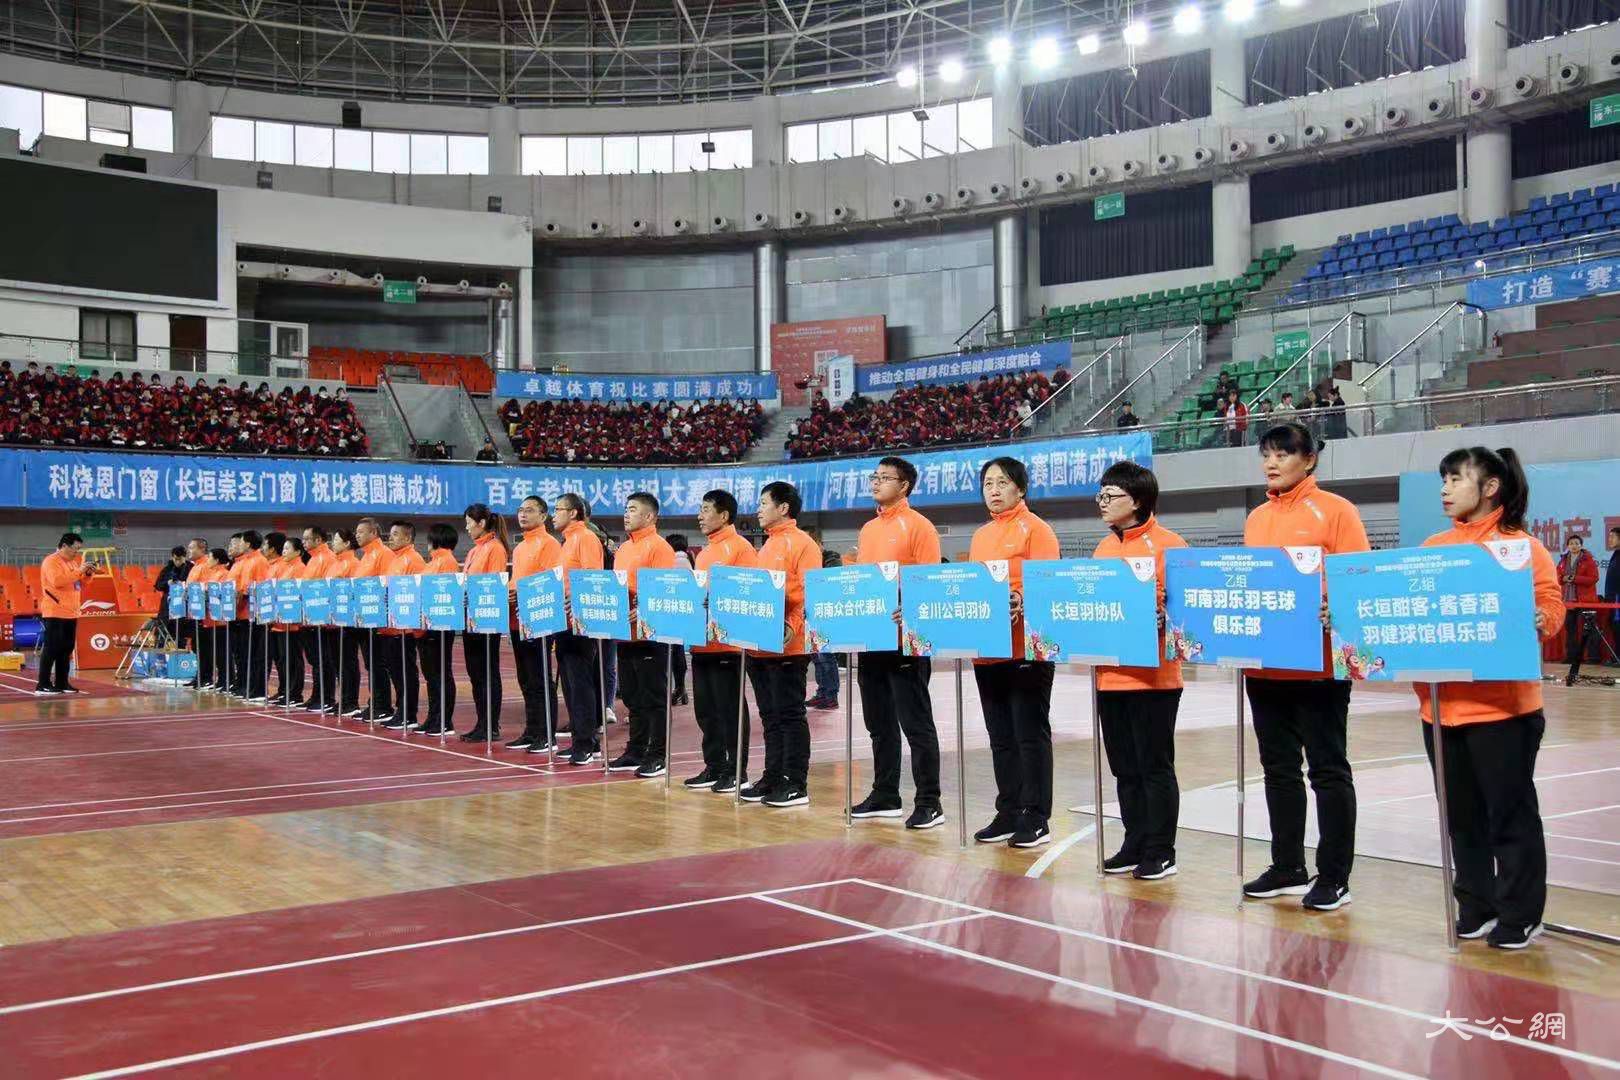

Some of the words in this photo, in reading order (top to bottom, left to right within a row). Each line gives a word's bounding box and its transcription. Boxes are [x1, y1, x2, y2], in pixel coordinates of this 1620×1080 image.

[869, 351, 1041, 385] 推动全民健身和全民健康深度融合
[1077, 582, 1096, 595] 乙组
[1224, 574, 1248, 588] 乙组
[1407, 577, 1436, 593] 乙组
[647, 597, 695, 614] 新乡羽林军队
[716, 596, 775, 618] 七零羽客代表队
[814, 598, 887, 619] 河南众合代表队
[1184, 588, 1297, 611] 河南羽乐羽毛球
[918, 600, 991, 620] 金川公司羽协
[1051, 601, 1125, 621] 长垣羽协队
[1213, 615, 1262, 636] 俱乐部
[1363, 621, 1498, 645] 羽健球馆俱乐部
